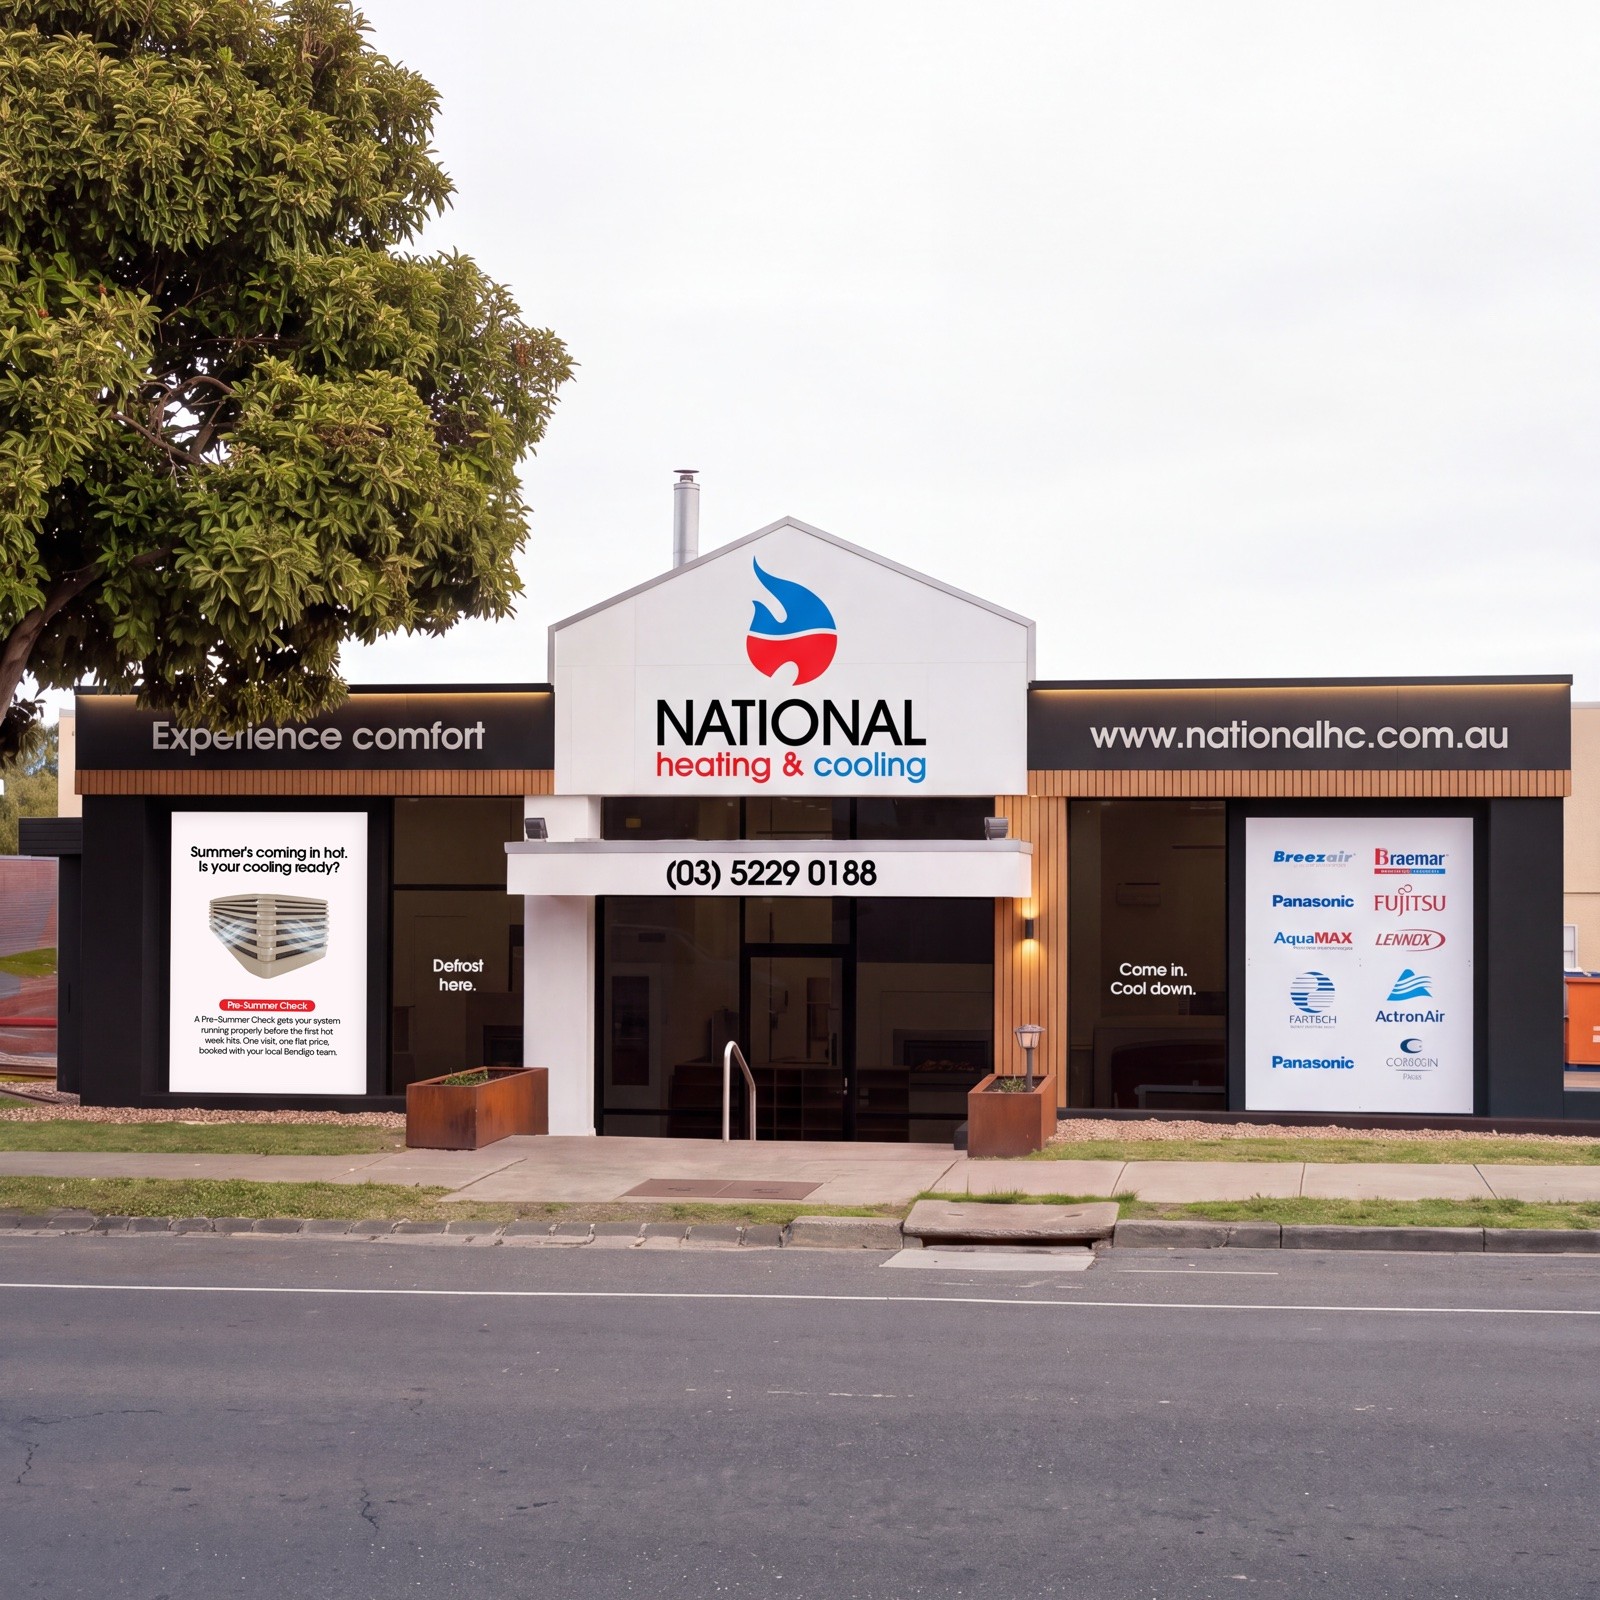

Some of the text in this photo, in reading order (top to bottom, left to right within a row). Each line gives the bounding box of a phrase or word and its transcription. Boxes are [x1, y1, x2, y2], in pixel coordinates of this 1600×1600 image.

[657, 699, 927, 746] NATIONAL
[352, 720, 485, 750] comfort
[1089, 720, 1509, 750] www.nationalhc.com.au
[656, 751, 928, 784] heating & cooling
[190, 846, 348, 862] Summer's coming in hot.
[1273, 850, 1353, 863] Breezair
[1374, 848, 1445, 866] Braemar
[198, 860, 341, 876] Is your cooling ready?
[666, 859, 877, 890] (03) 5229 0188
[1272, 894, 1355, 908] Panasonic
[1374, 888, 1446, 917] FUJITSU
[1273, 931, 1353, 946] AquaMAX
[1374, 932, 1433, 947] LENNOX
[433, 958, 485, 973] Defrost
[1119, 962, 1188, 977] Come in.
[439, 977, 477, 992] here.
[1110, 981, 1197, 996] Cool down.
[227, 1001, 308, 1010] Pre-Summer Check
[194, 1015, 341, 1026] A Pre-Summer Check gets your system
[1375, 1009, 1446, 1023] ActronAir
[201, 1026, 334, 1036] running properly before the first hot
[205, 1037, 330, 1047] week hits. One visit, one flat price,
[199, 1046, 338, 1058] booked with your local Bendigo team.
[1271, 1056, 1355, 1070] Panasonic
